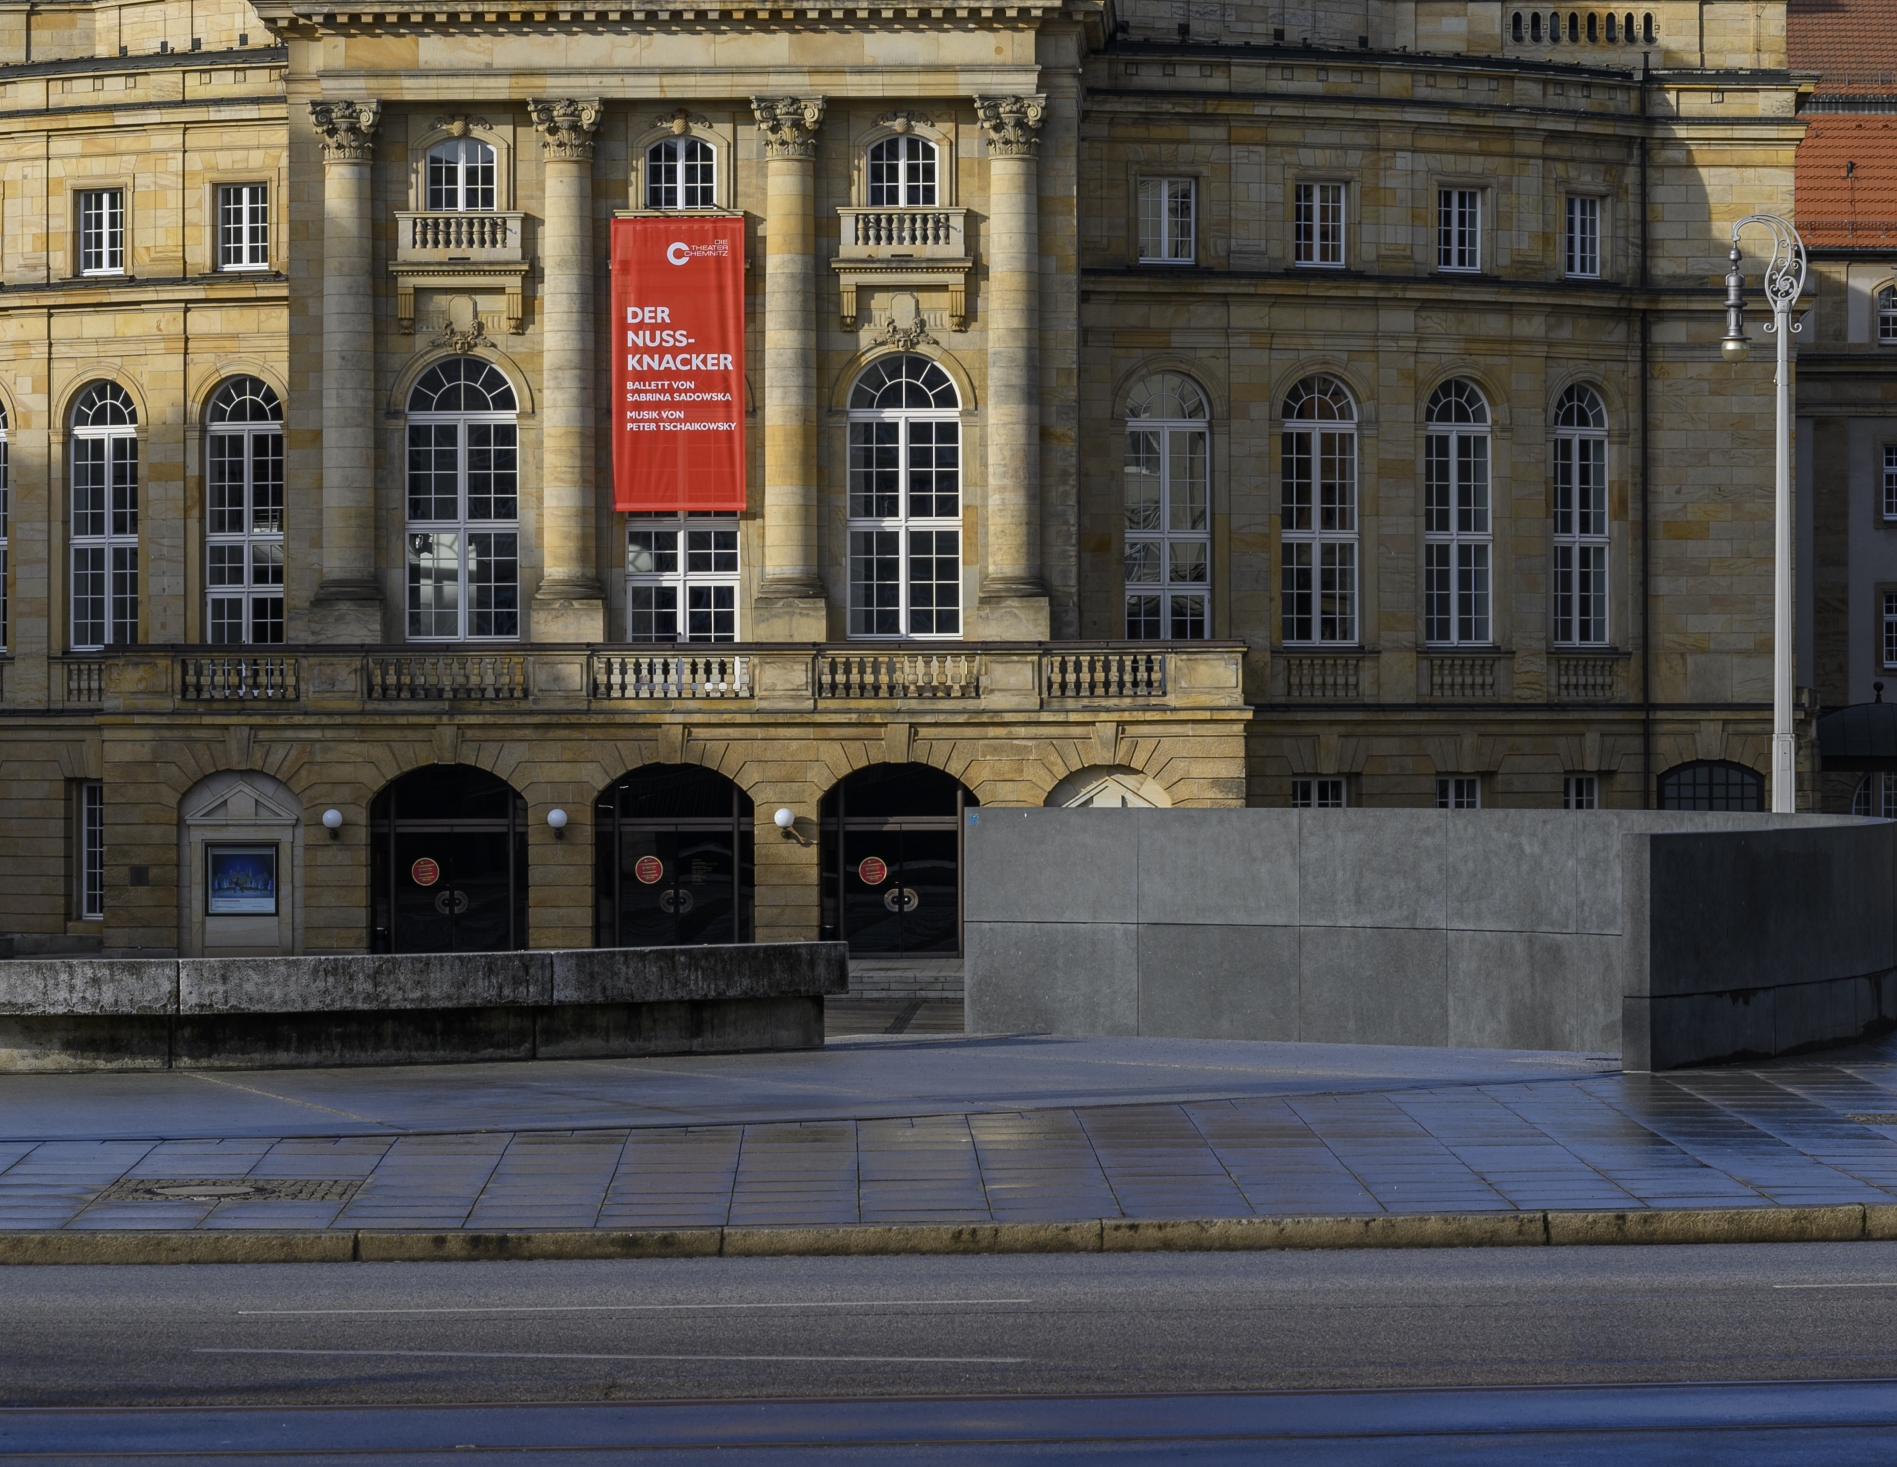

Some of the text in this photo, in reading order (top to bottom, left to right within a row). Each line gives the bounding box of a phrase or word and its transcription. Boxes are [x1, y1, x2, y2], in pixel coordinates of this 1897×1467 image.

[627, 306, 671, 324] DER
[627, 330, 695, 347] NUSS-
[627, 353, 733, 371] KNACKER
[627, 381, 694, 390] BALLETT VON
[627, 393, 732, 401] SABRINA SADOWSKA
[627, 411, 684, 419] MUSIK VON
[627, 422, 736, 431] PETER TSCHAIKOWSKY
